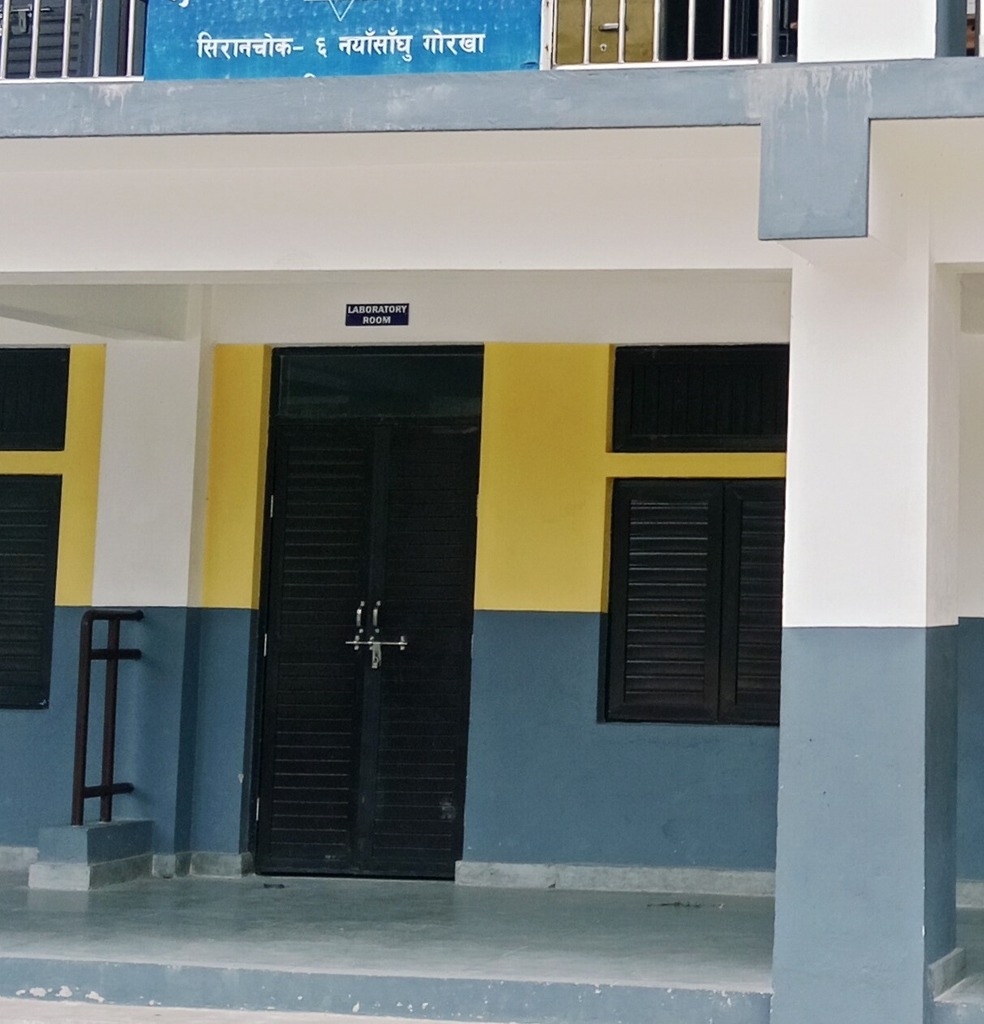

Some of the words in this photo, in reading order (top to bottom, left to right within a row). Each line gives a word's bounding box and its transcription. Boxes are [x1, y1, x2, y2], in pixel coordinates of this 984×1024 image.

[315, 37, 329, 59] ६
[423, 29, 486, 55] गोरखा
[347, 305, 407, 314] LABORATORY
[362, 316, 391, 324] ROOM
